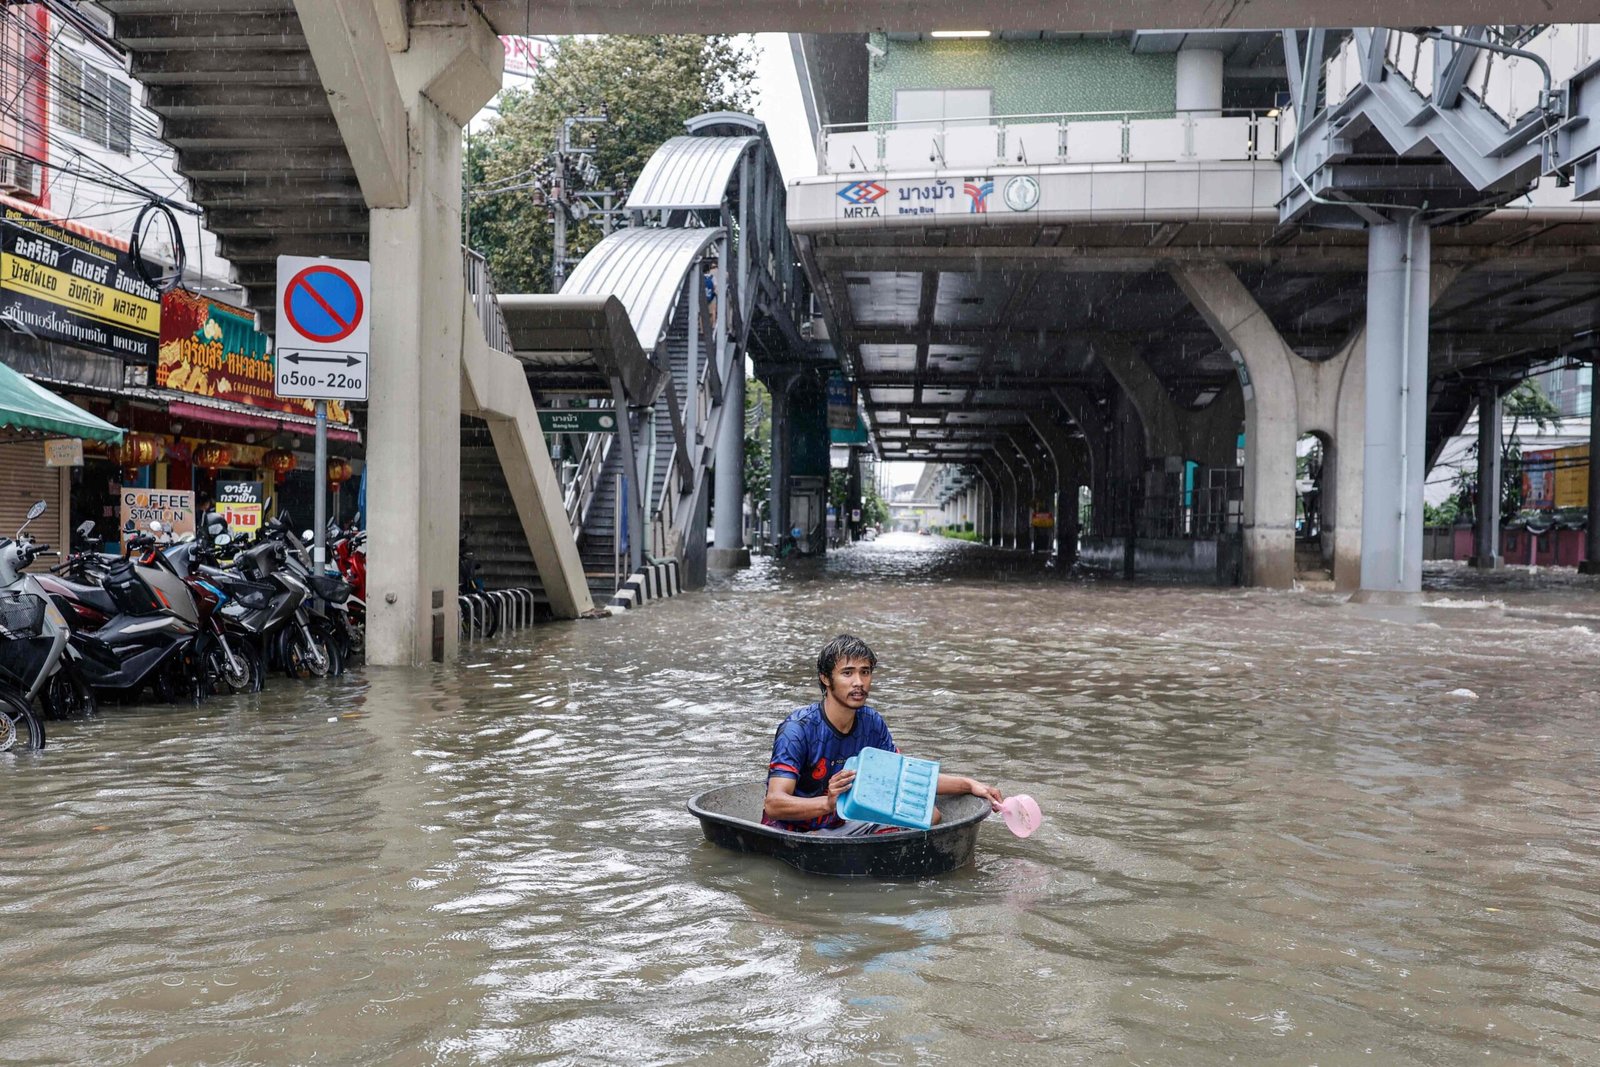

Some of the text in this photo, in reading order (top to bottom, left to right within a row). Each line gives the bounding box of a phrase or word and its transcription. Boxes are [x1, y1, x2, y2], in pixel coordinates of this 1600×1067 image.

[899, 180, 954, 200] บางบัว
[844, 207, 880, 218] MRTA
[899, 206, 918, 215] Bang
[552, 413, 578, 422] บางบัว
[125, 493, 189, 508] COFFEE
[130, 509, 183, 521] STATION
